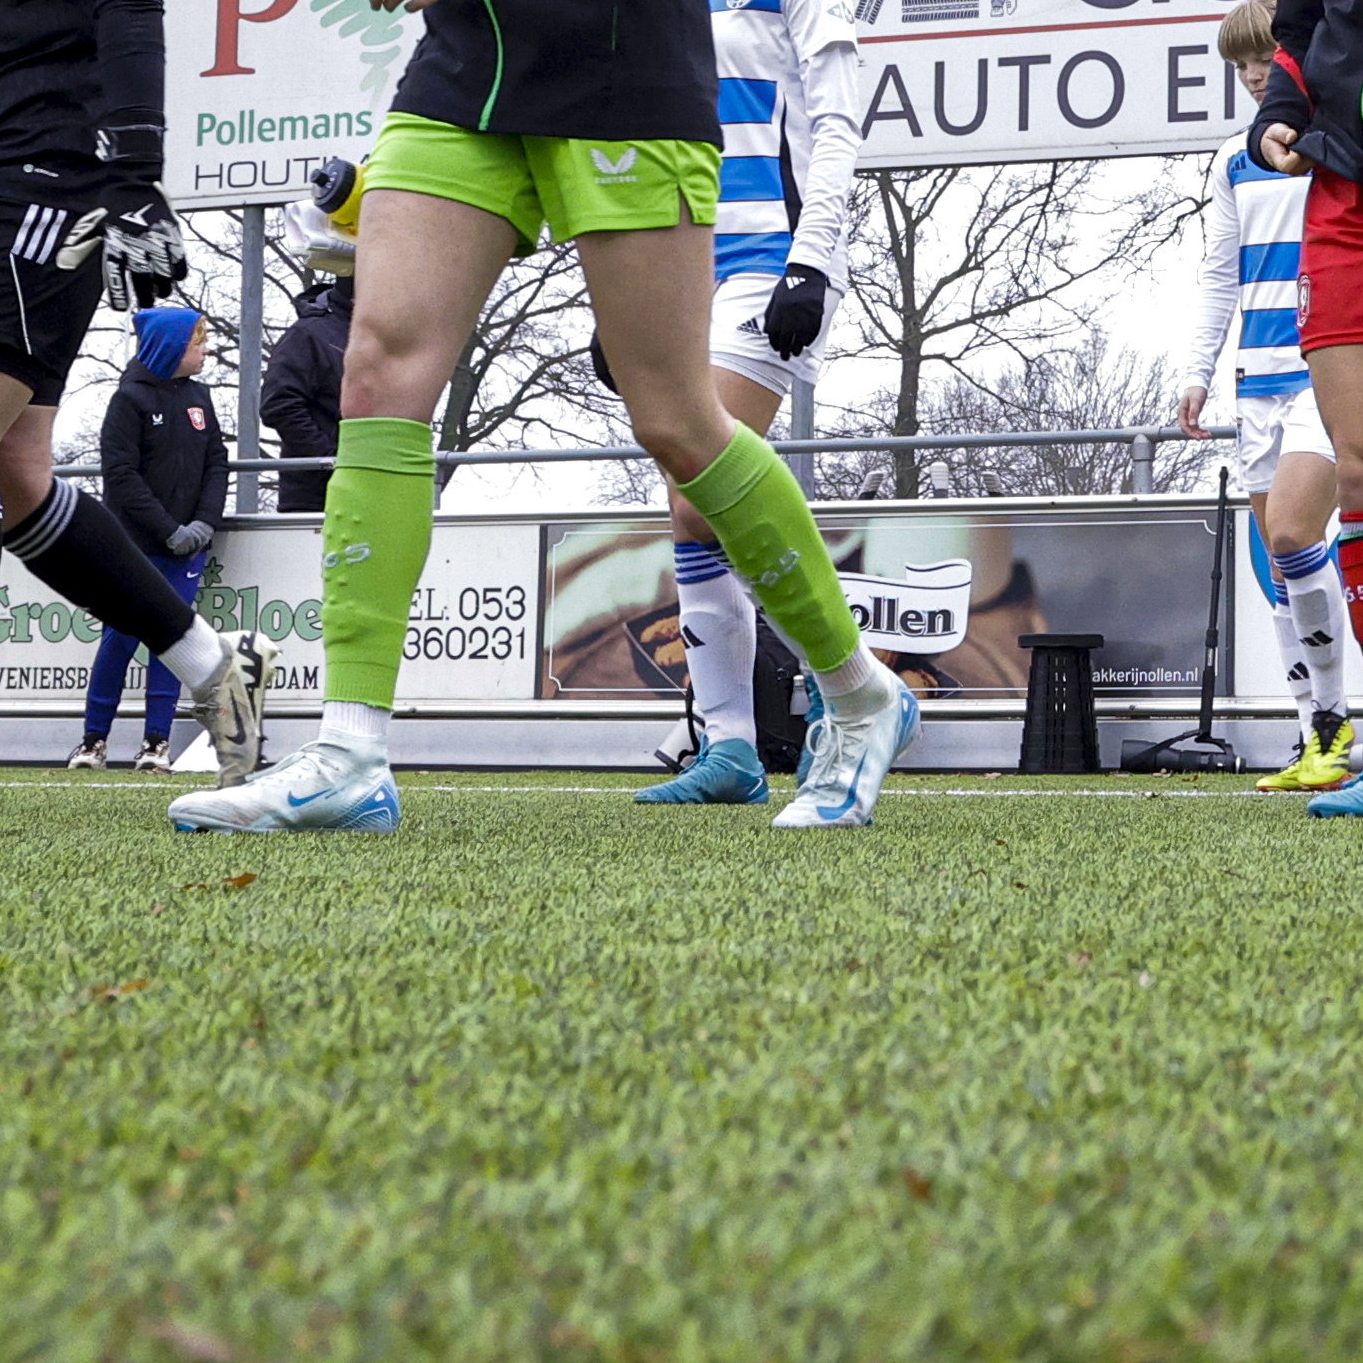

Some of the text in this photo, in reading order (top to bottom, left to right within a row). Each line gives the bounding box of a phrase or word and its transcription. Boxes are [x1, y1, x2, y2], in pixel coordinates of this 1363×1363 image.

[862, 50, 1125, 138] AUTO
[196, 109, 373, 147] Pollemans
[459, 586, 526, 621] 053
[848, 592, 958, 637] ollen
[1092, 667, 1198, 685] akkerijnollen.nl
